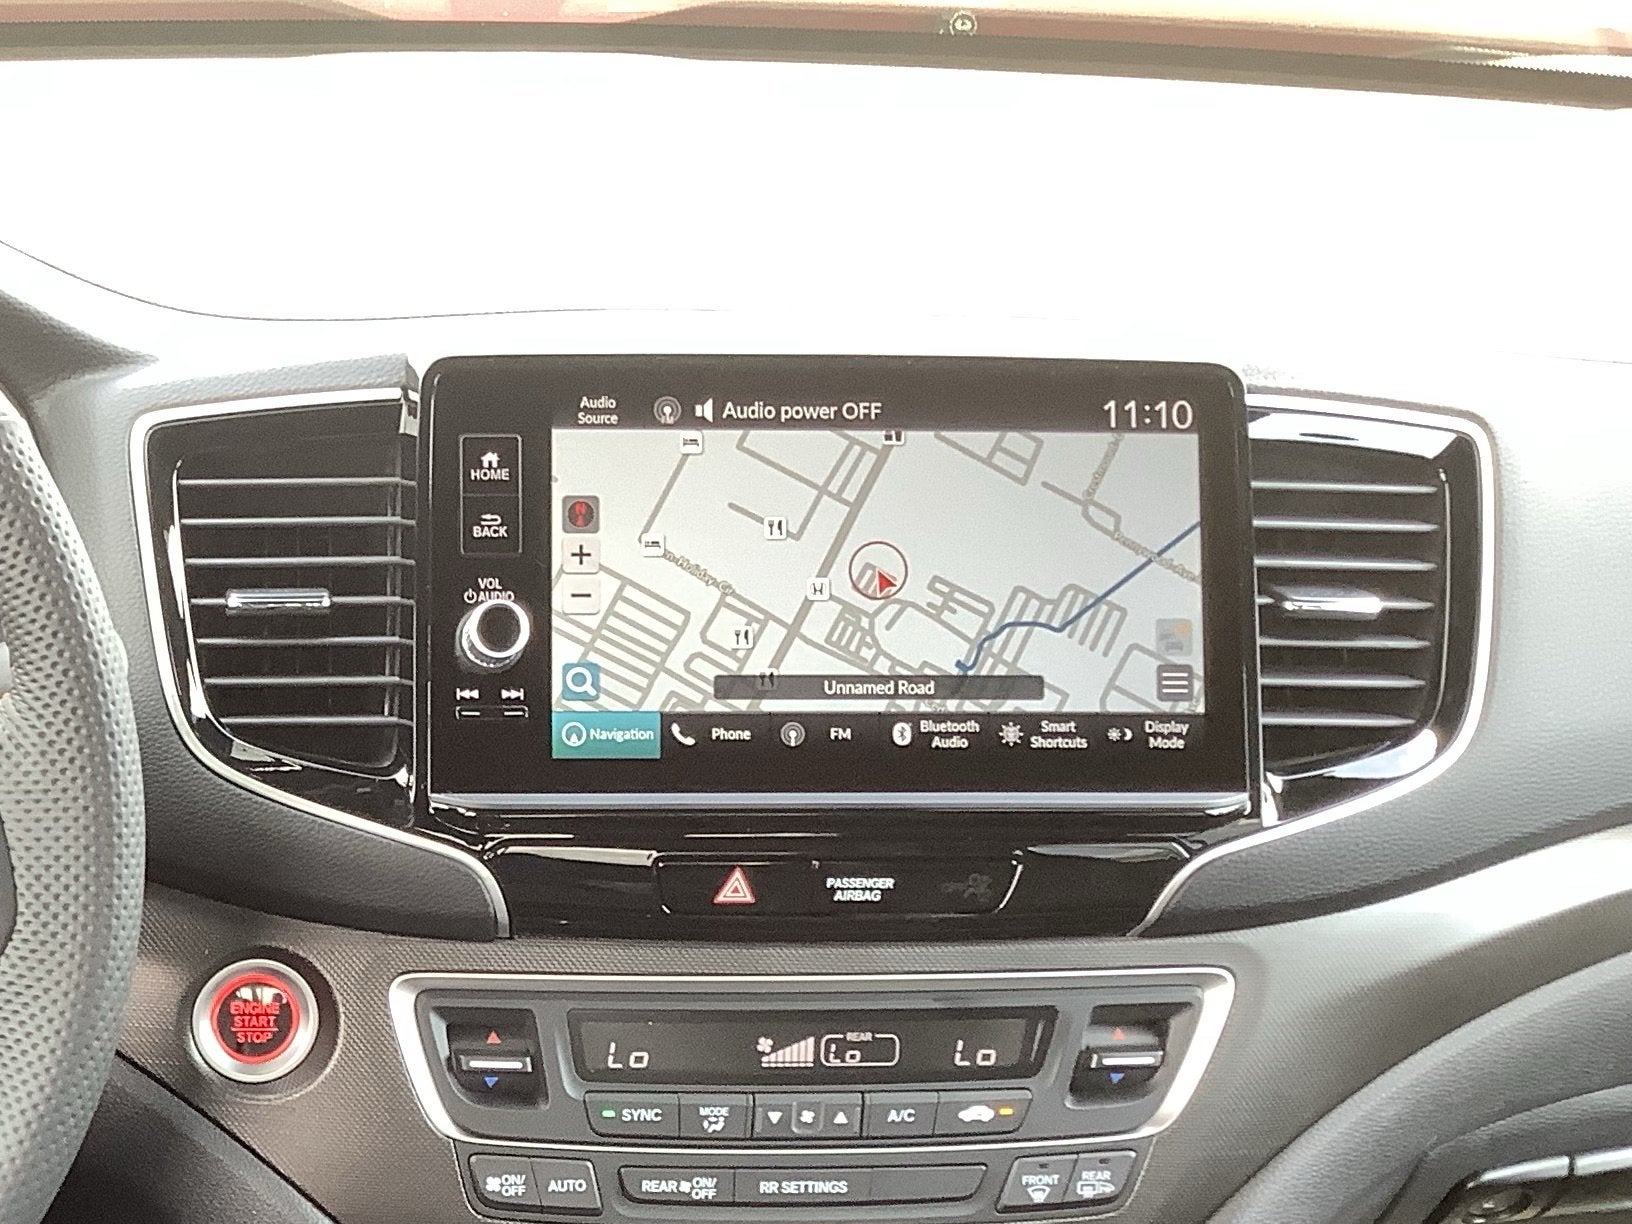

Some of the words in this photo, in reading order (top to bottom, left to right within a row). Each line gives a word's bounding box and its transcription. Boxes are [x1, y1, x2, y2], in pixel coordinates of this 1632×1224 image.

[579, 395, 617, 409] Audio
[577, 411, 619, 425] Source
[722, 401, 776, 420] Audio
[780, 405, 838, 423] power
[841, 402, 882, 420] OFF
[1103, 399, 1194, 430] 11:10
[470, 467, 510, 481] HOME
[472, 524, 508, 538] BACK
[478, 577, 503, 590] VOL
[478, 590, 515, 601] AUDIO
[823, 679, 895, 695] Unnamed
[897, 679, 935, 695] Road
[919, 719, 981, 733] Bluetooth
[1040, 719, 1077, 733] Smart
[1144, 720, 1190, 737] Display
[589, 726, 656, 743] Navigation
[711, 727, 752, 741] Phone
[830, 727, 852, 740] FM
[931, 735, 969, 749] Audio
[1030, 735, 1088, 749] Shortcuts
[1149, 735, 1186, 750] Mode
[825, 877, 895, 889] PASSENGER
[833, 889, 882, 902] AIRBAG
[229, 1001, 280, 1015] ENGINE
[233, 1015, 277, 1028] START
[236, 1032, 273, 1044] STOP
[621, 1108, 663, 1122] SYNC
[699, 1106, 730, 1118] MODE
[887, 1108, 916, 1123] A/C
[1021, 1174, 1060, 1186] FRONT
[1081, 1170, 1112, 1181] REAR
[501, 1185, 527, 1197] OFF
[547, 1178, 587, 1193] AUTO
[641, 1179, 678, 1194] REAR
[759, 1180, 780, 1194] RR
[780, 1180, 849, 1194] SETTINGS
[691, 1188, 717, 1200] OFF
